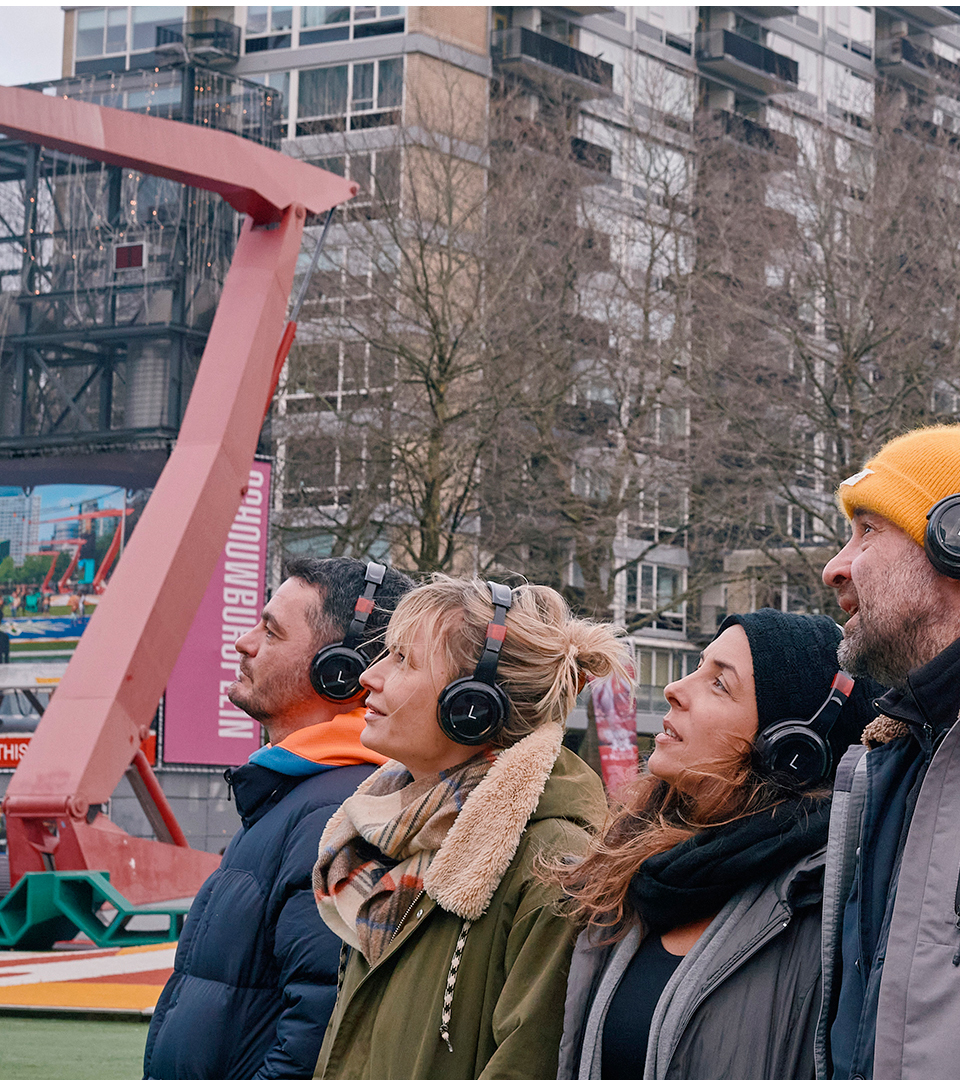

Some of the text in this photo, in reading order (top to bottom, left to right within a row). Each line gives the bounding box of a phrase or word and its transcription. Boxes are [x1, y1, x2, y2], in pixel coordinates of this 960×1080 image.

[338, 670, 345, 684] L
[468, 705, 477, 720] L
[789, 753, 799, 770] L
